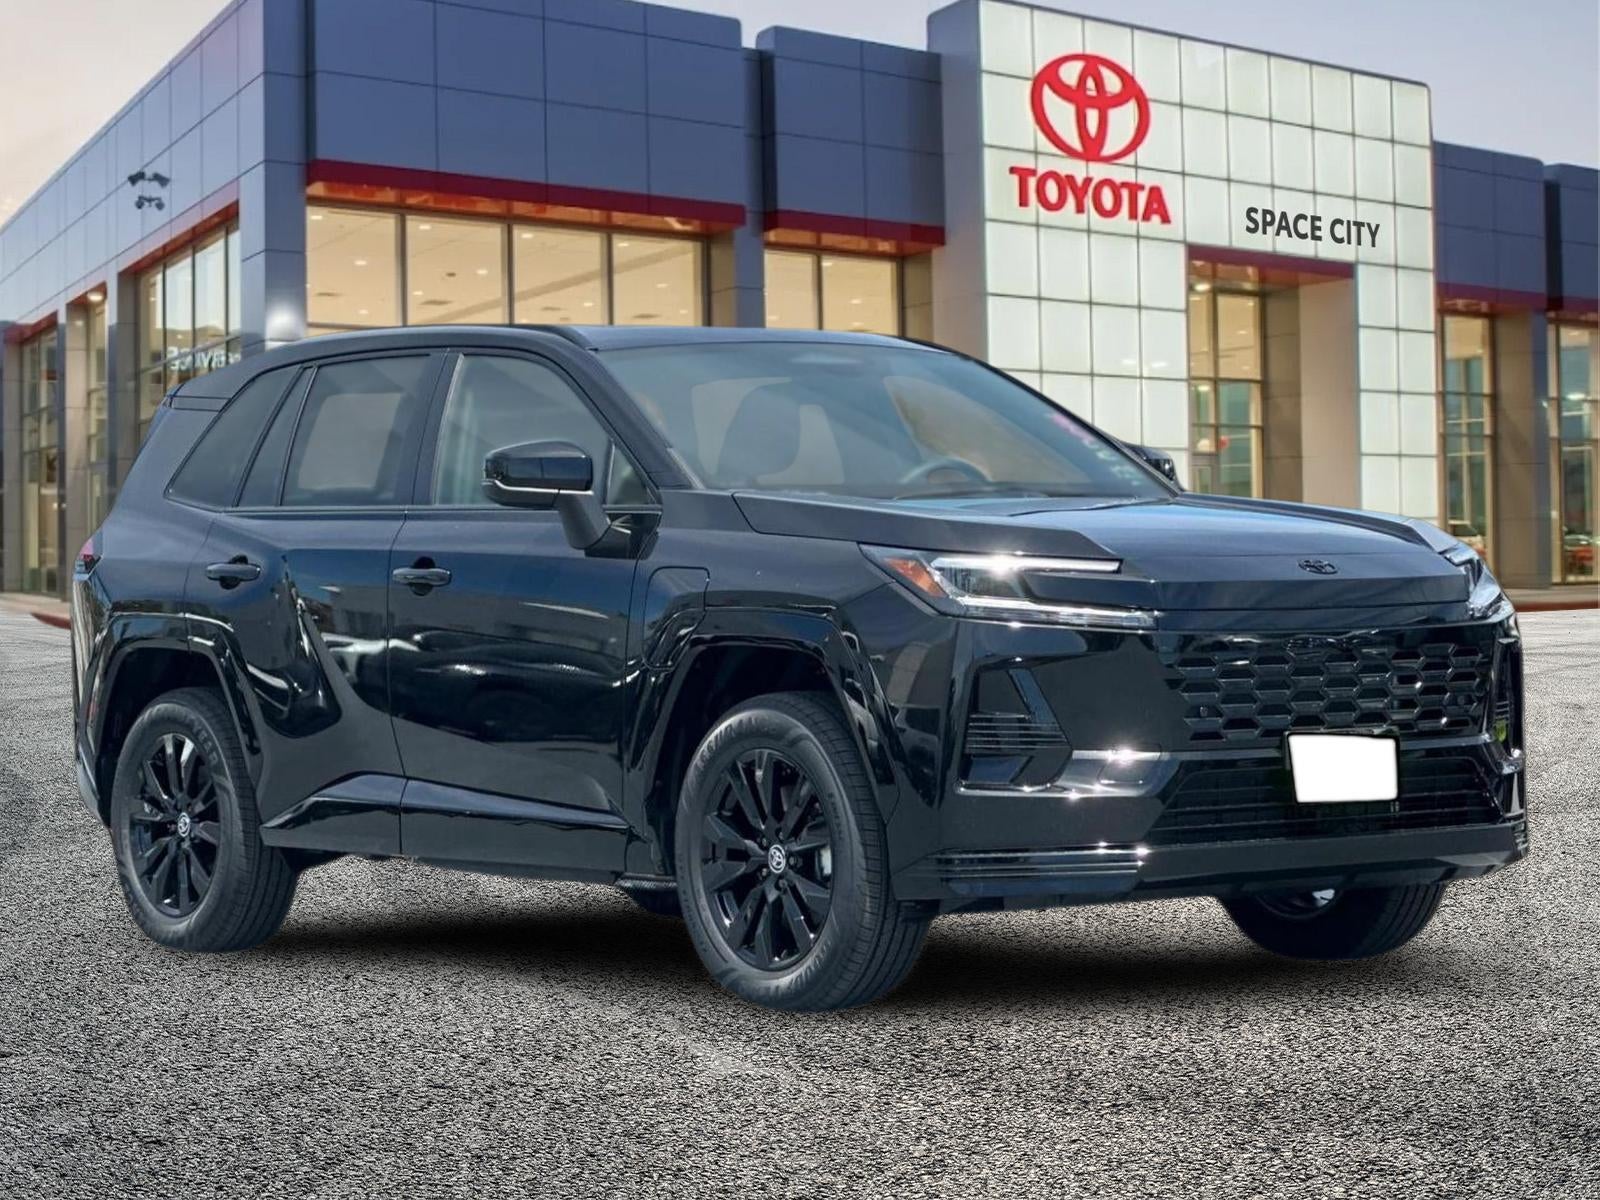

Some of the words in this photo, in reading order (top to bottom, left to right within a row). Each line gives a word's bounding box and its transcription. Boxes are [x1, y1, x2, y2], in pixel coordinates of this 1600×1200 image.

[1009, 166, 1171, 224] TOYOTA
[1245, 206, 1323, 242] SPACE
[1329, 218, 1381, 248] CITY
